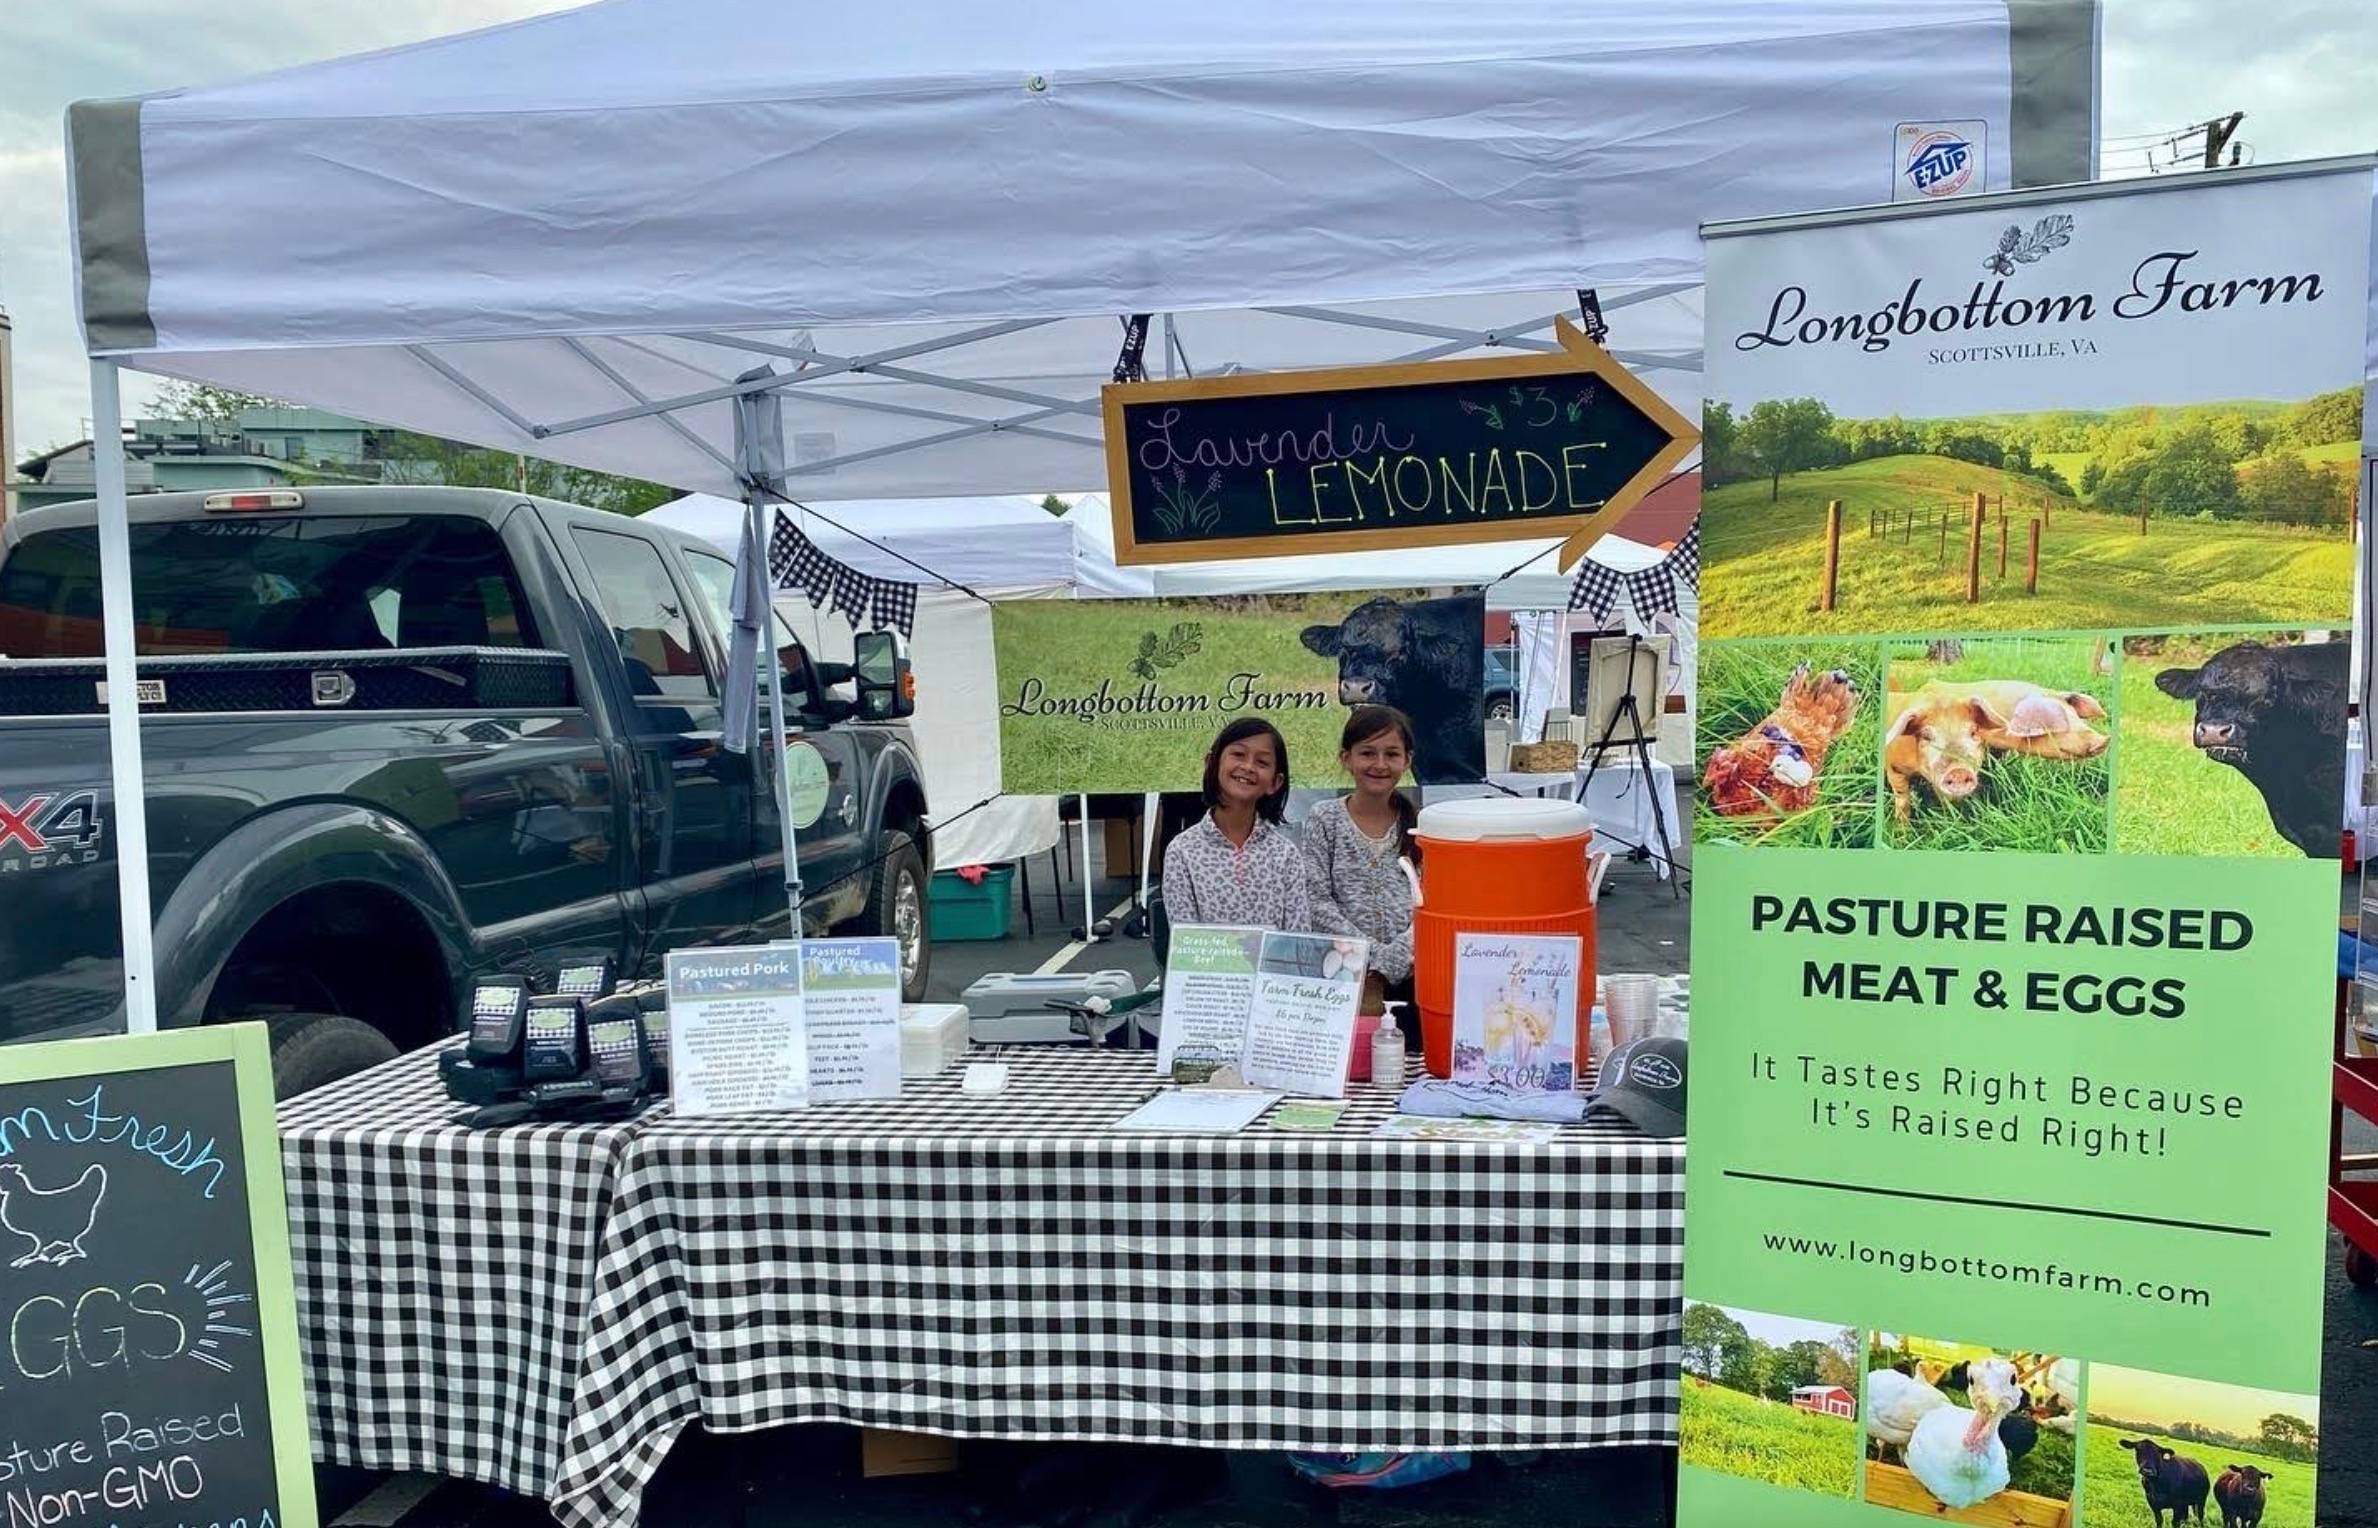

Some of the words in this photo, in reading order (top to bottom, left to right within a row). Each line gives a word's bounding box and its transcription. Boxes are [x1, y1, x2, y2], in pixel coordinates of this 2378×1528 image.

[1735, 277, 2096, 352] Longbottom
[2112, 249, 2325, 319] Farm
[1928, 341, 2066, 365] SCOTTSVILLE,
[2071, 339, 2098, 356] VA
[1140, 408, 1415, 470] Lavender
[1508, 386, 1558, 427] $3
[1265, 442, 1608, 525] LEMONADE
[1000, 677, 1210, 722] Longbottom
[1216, 672, 1327, 712] Farm
[2, 850, 100, 873] ROAD
[809, 945, 861, 957] Pastured
[1462, 943, 1517, 958] Lavender
[1751, 894, 2008, 941] PASTURE
[2025, 904, 2254, 951] RAISED
[680, 962, 750, 980] Pastured
[753, 960, 790, 976] Pork
[1292, 982, 1323, 1000] Fresh
[1325, 986, 1351, 1005] Eggs
[1509, 961, 1570, 977] Lemonade
[1803, 961, 1960, 1006] MEAT
[1972, 969, 2009, 1010] &
[2025, 972, 2187, 1019] EGGS
[1752, 1052, 1777, 1081] It
[1796, 1055, 1921, 1092] Tastes
[1943, 1067, 2047, 1106] Right
[2070, 1076, 2243, 1119] Because
[64, 1083, 225, 1199] Fresh
[1812, 1097, 1871, 1129] It's
[1892, 1105, 2019, 1143] Raised
[2042, 1117, 2165, 1158] Right!
[1762, 1232, 2212, 1308] www.longbottomfarm.com
[100, 1402, 245, 1459] Raised
[6, 1455, 203, 1528] Non-GMO
